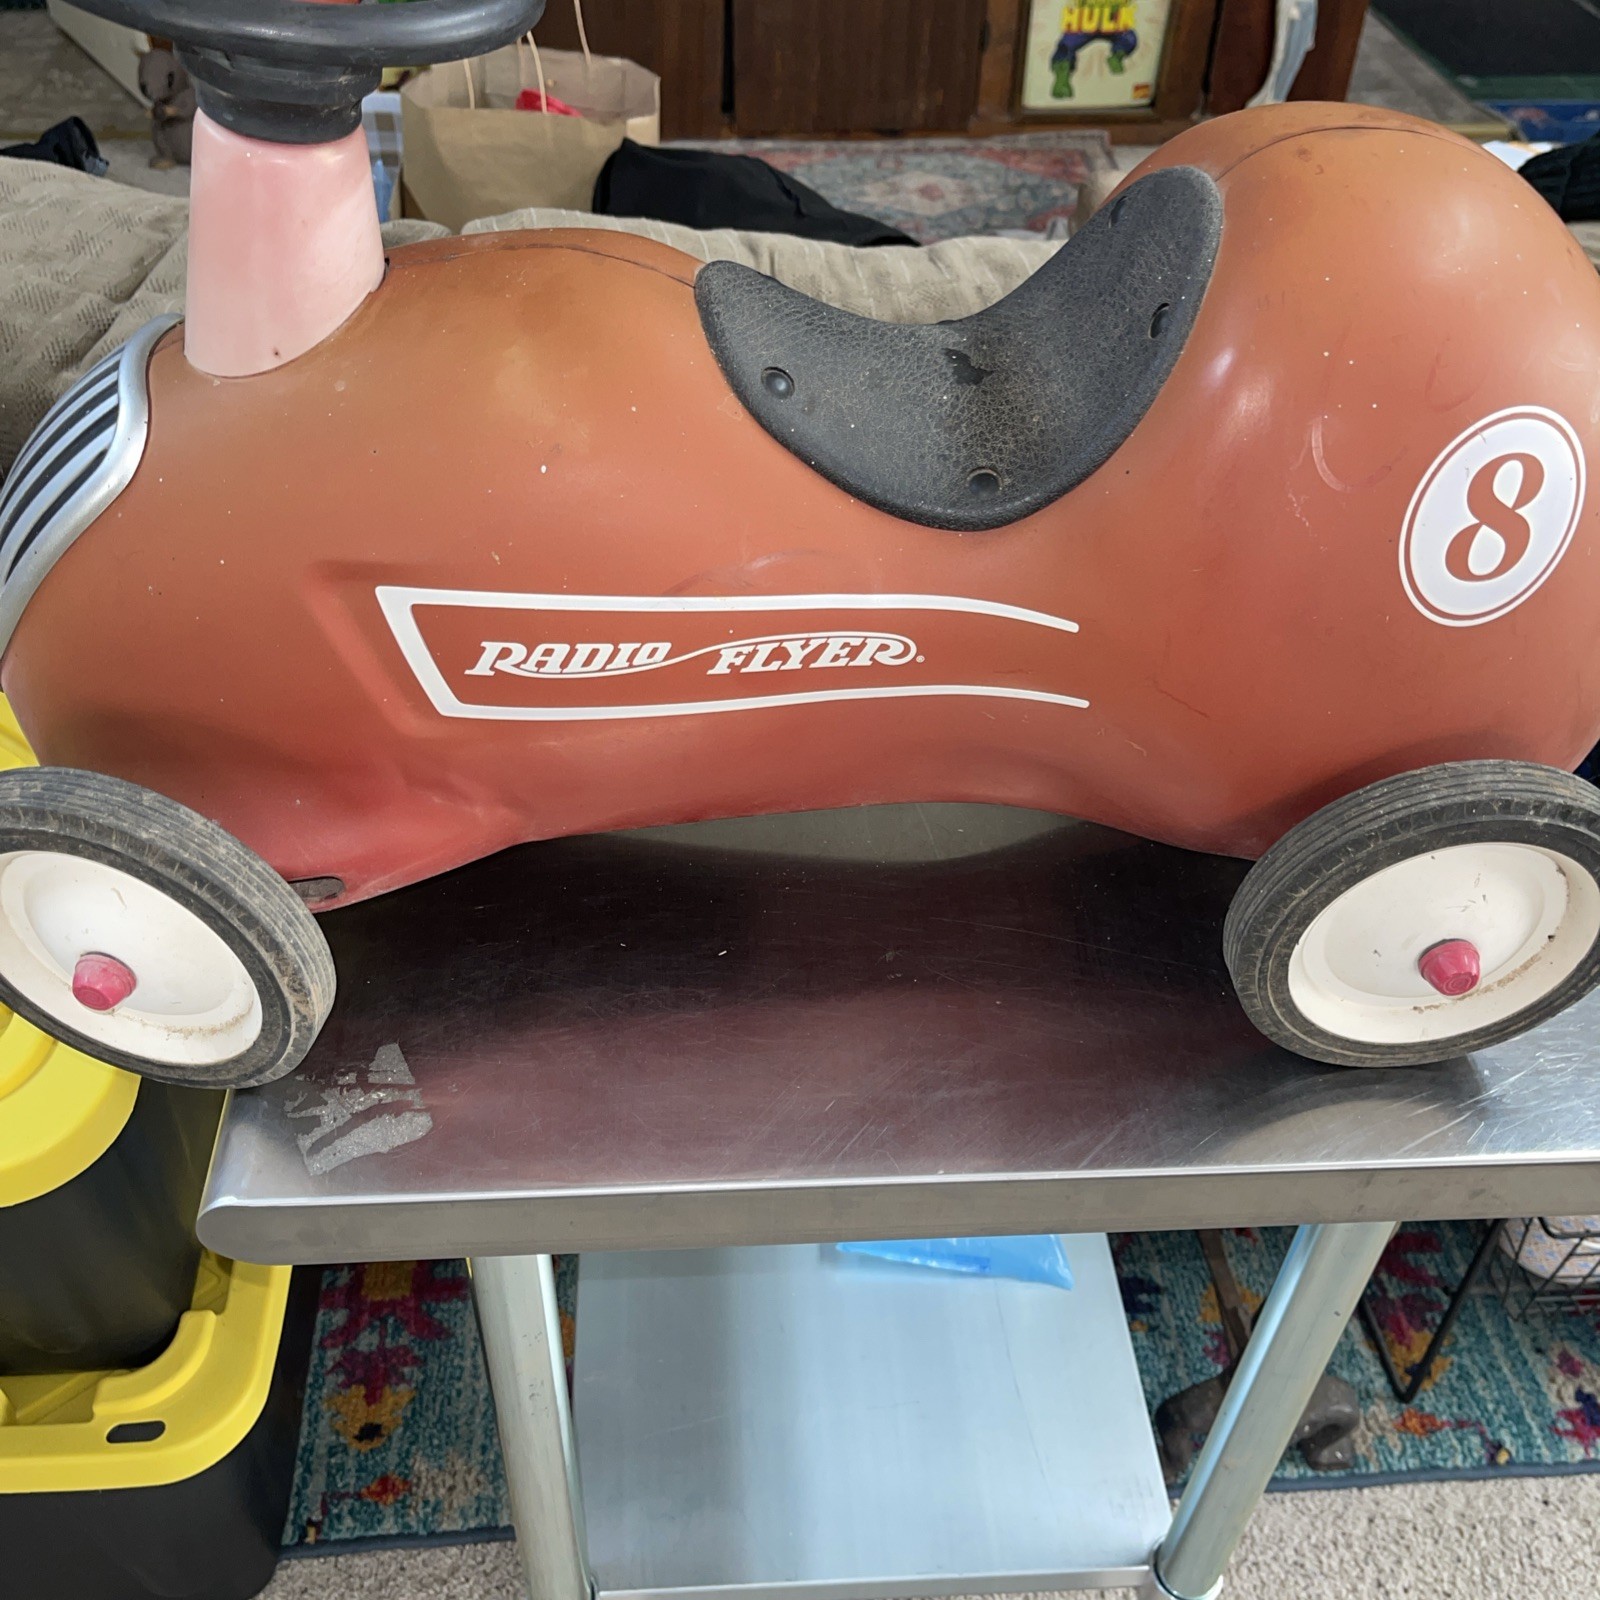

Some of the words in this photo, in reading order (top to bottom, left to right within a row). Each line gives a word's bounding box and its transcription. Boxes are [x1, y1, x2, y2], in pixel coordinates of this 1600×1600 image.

[1062, 6, 1136, 32] HULK
[1445, 452, 1545, 582] 8
[464, 641, 672, 678] RADIO
